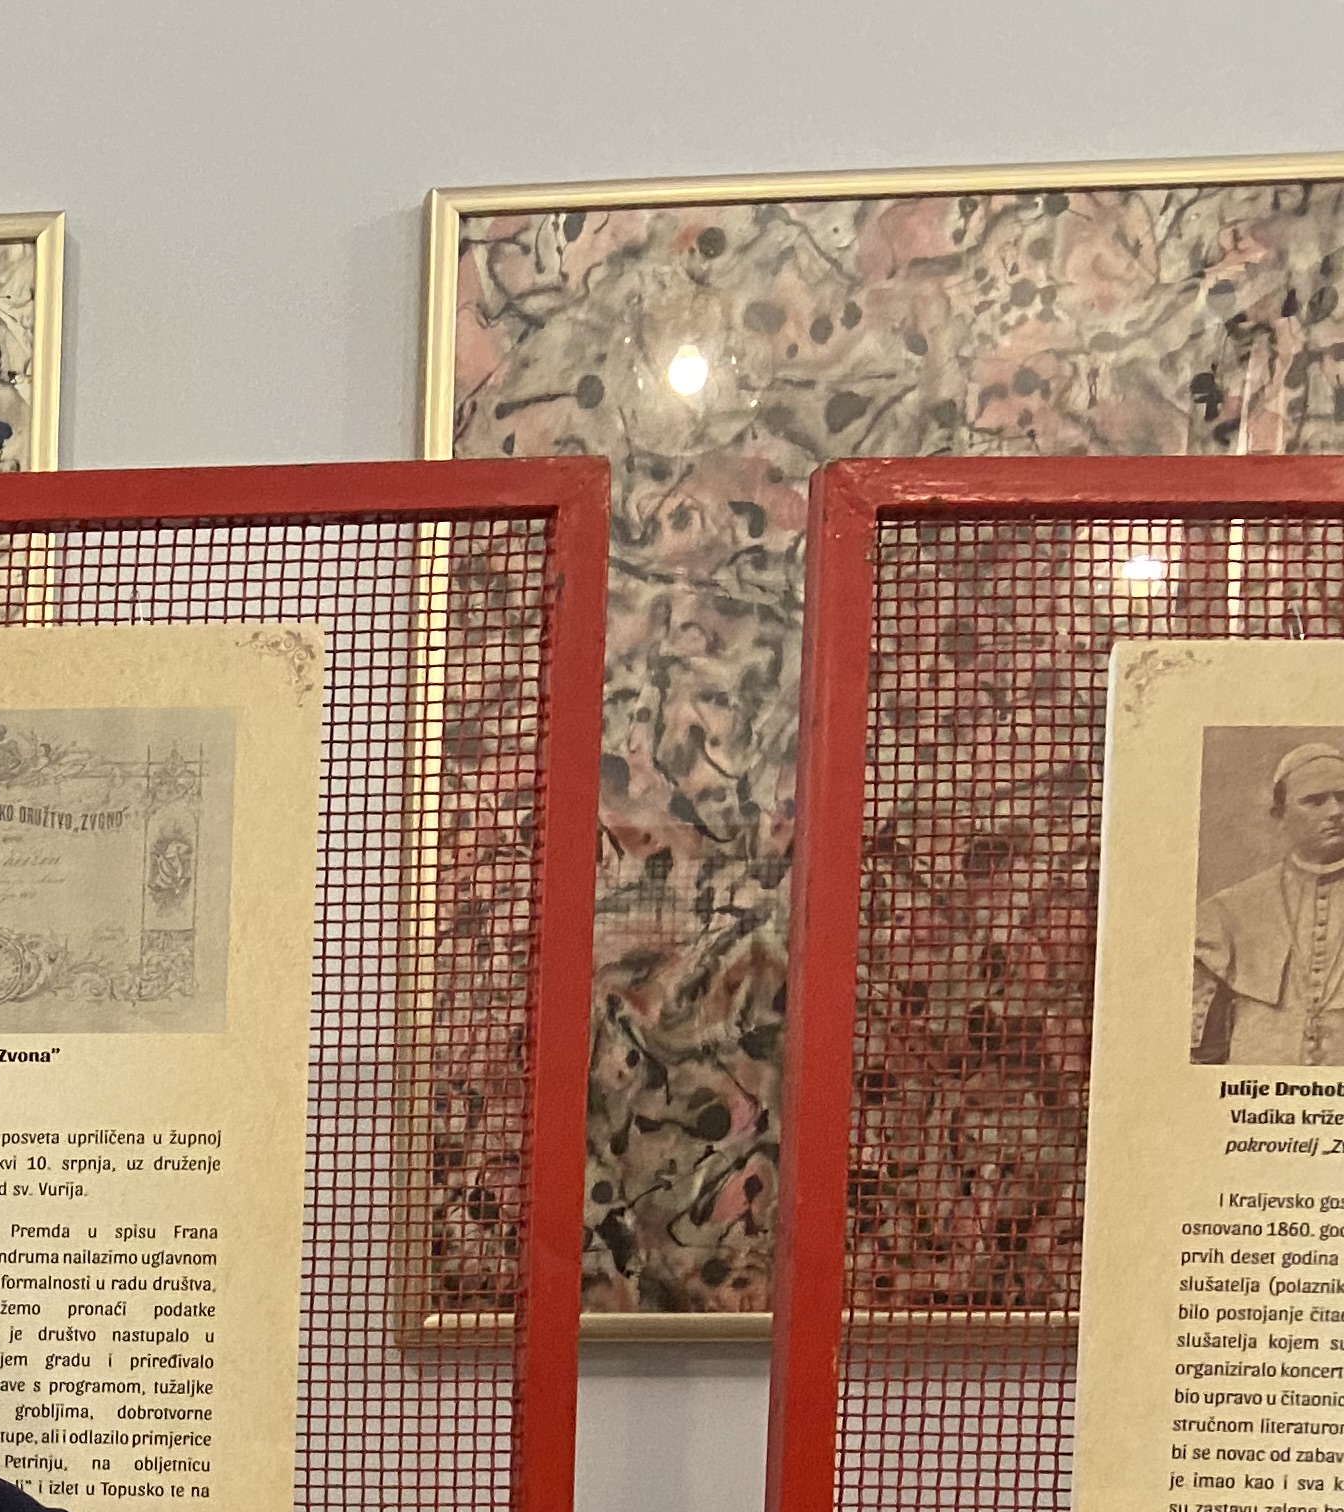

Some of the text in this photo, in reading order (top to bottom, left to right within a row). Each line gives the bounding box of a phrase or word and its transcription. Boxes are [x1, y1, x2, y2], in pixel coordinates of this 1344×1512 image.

[1220, 1078, 1270, 1098] Julije
[1231, 1108, 1296, 1125] Vladika
[2, 1131, 60, 1147] posveta
[68, 1129, 145, 1148] upriličena
[153, 1133, 163, 1144] u
[170, 1129, 222, 1148] župnoj
[1225, 1136, 1320, 1156] pokrovitelj
[27, 1155, 52, 1170] 10.
[62, 1155, 116, 1174] srpnja,
[127, 1158, 144, 1170] uz
[154, 1154, 221, 1175] druženje
[1229, 1192, 1315, 1211] Kraljevsko
[12, 1223, 218, 1242] Premda u spisu Frana
[1182, 1221, 1315, 1237] osnovano 1860.
[64, 1248, 138, 1265] nailazimo
[142, 1249, 217, 1268] uglavnom
